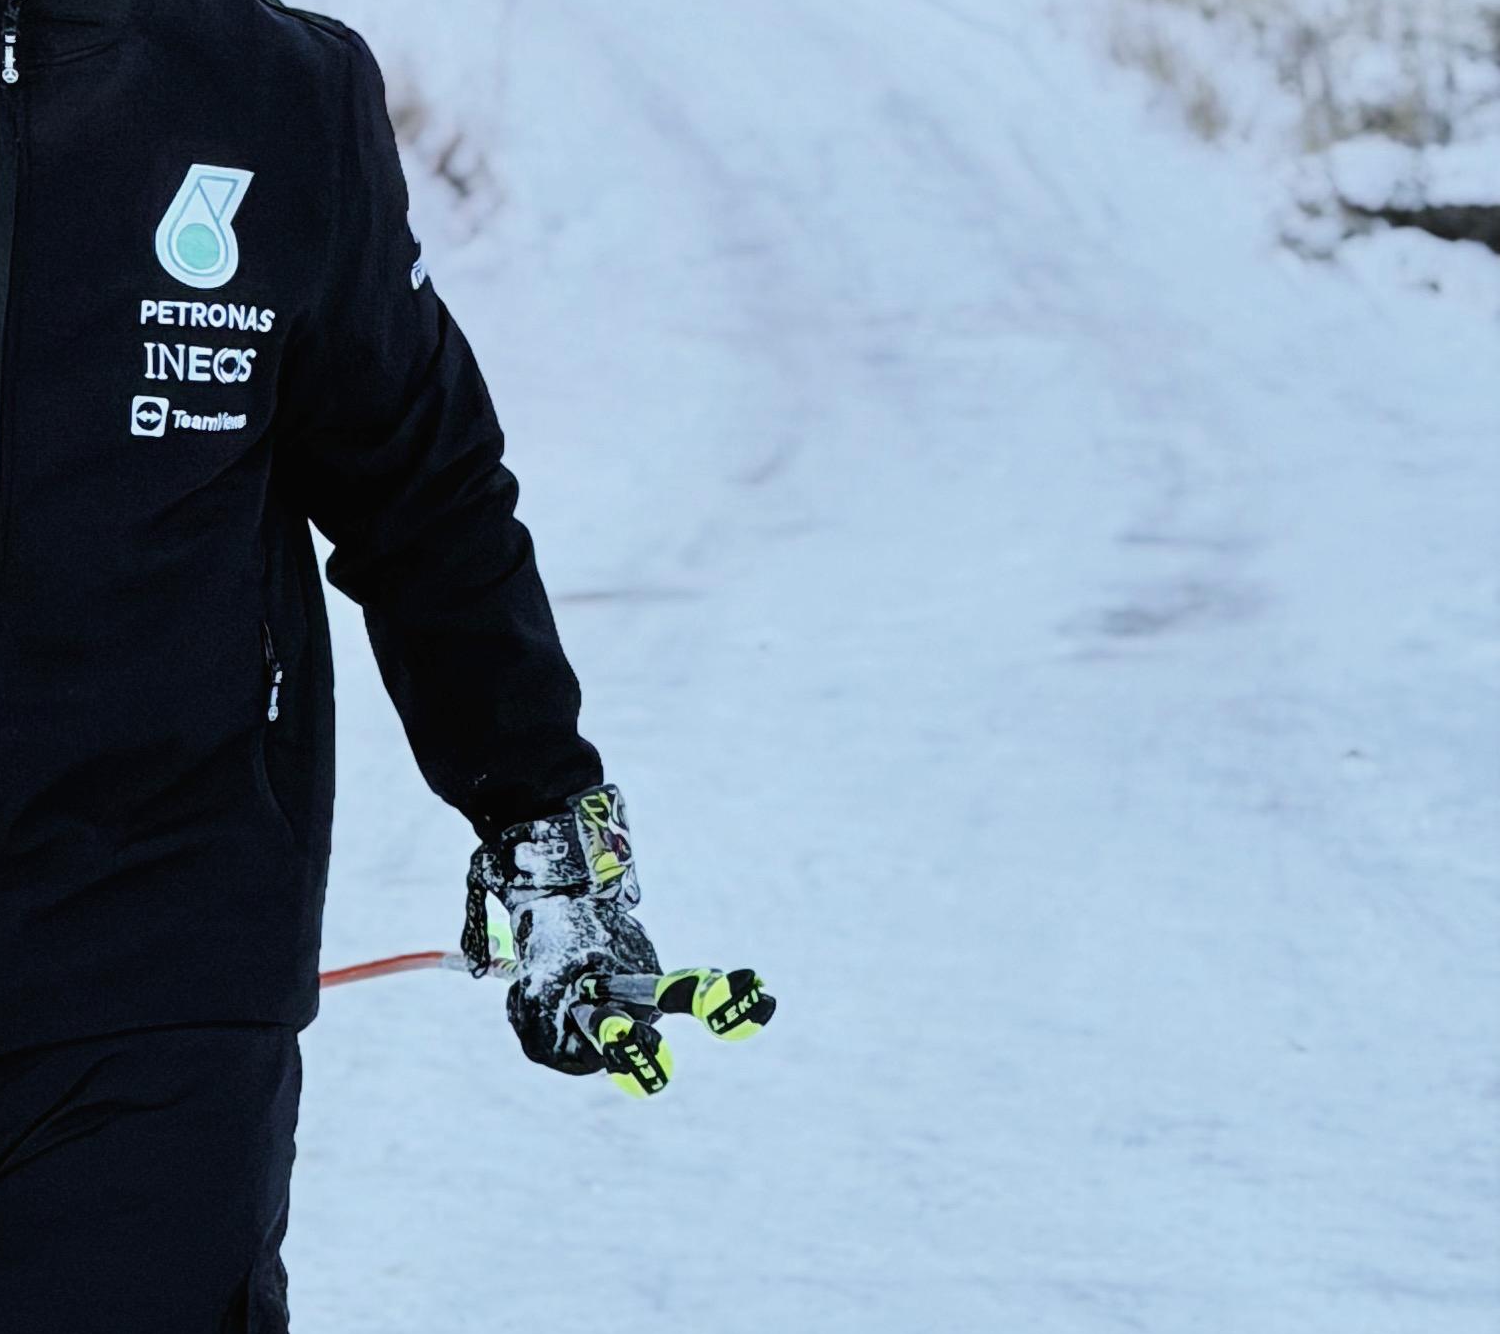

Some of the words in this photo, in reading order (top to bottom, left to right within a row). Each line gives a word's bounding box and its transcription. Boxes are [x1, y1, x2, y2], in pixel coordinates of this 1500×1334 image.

[140, 299, 275, 332] PETRONAS
[143, 342, 257, 383] INEOS
[711, 989, 760, 1031] LEKI
[624, 1043, 664, 1091] LEKI
